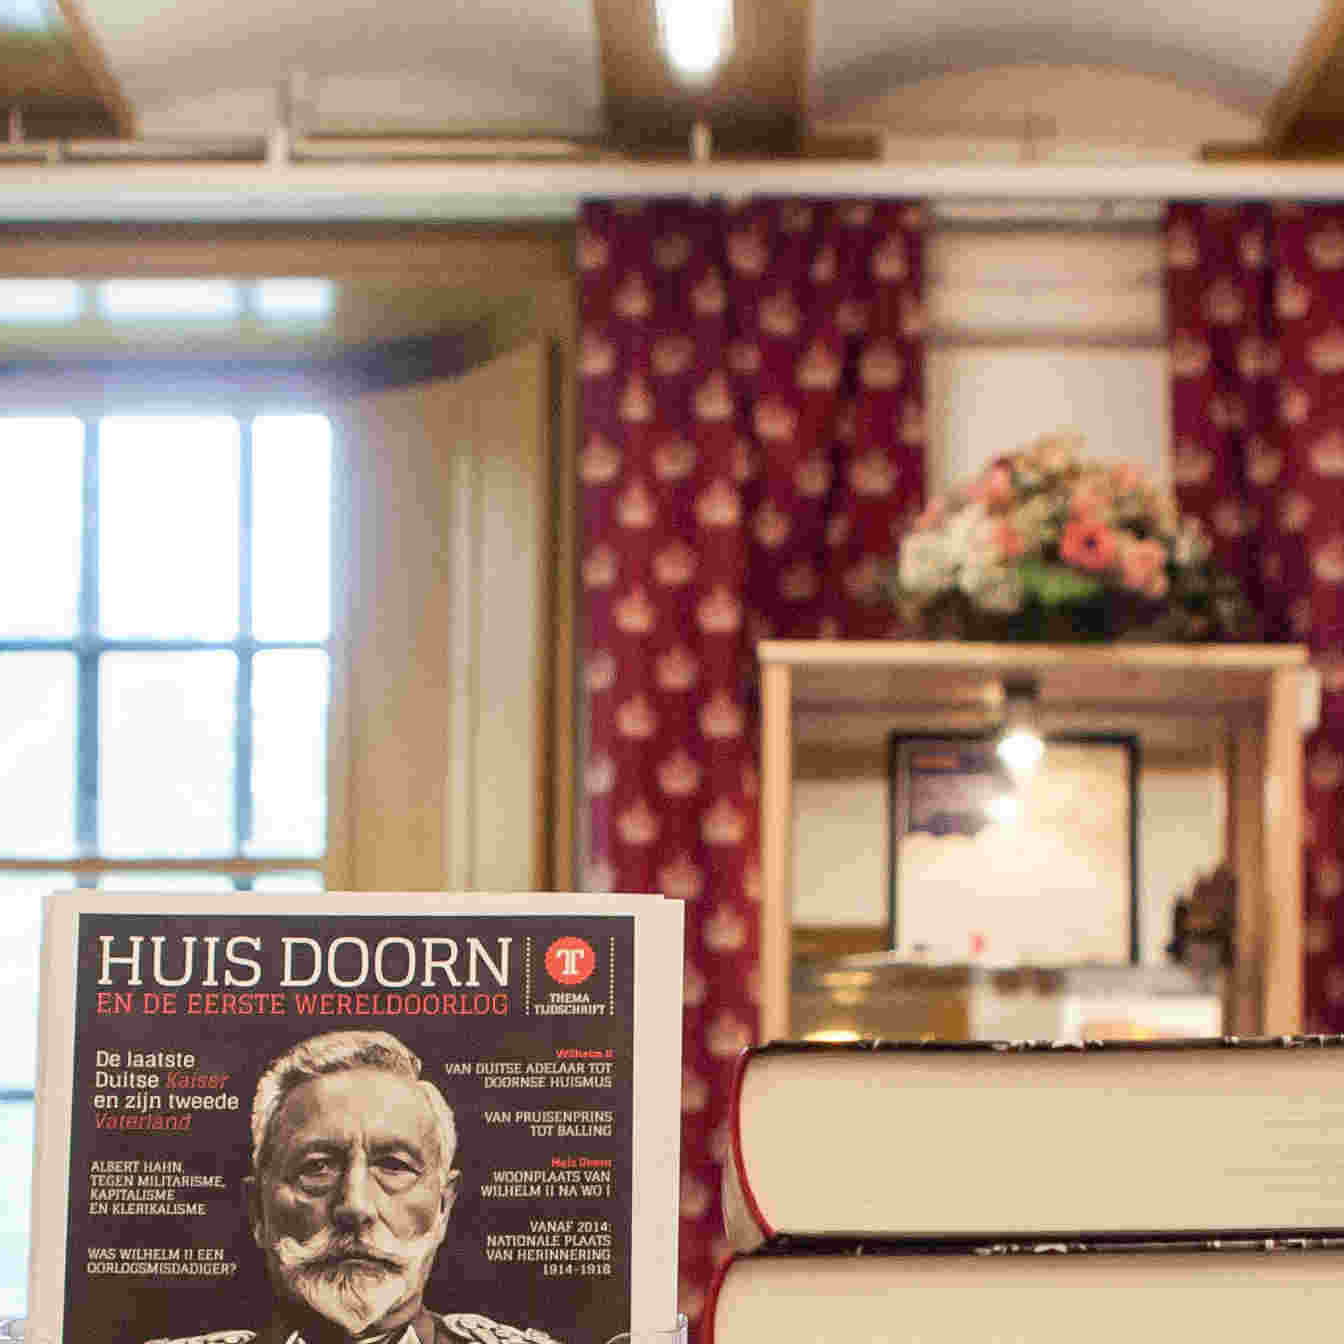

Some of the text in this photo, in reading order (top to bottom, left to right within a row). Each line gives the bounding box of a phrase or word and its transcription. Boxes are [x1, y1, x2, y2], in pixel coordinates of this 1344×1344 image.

[97, 935, 512, 987] HUIS DOORN
[556, 949, 585, 975] T
[549, 993, 590, 1003] THEMA
[97, 994, 509, 1017] EN DE EERSTE WERELDOORLOG
[96, 1051, 195, 1068] De laatste
[445, 1063, 613, 1074] VAN DUITSE ADELAAR TOT
[96, 1071, 159, 1088] Duitse
[484, 1077, 612, 1088] DOORNSE HUISMUS
[94, 1092, 240, 1112] en zijn tweede
[96, 1113, 193, 1130] Vaterland
[485, 1112, 613, 1122] VAN PRUISENPRINS
[530, 1126, 612, 1137] TOT BALLING
[90, 1161, 139, 1173] ALBERT
[90, 1175, 134, 1187] TEGEN
[493, 1171, 610, 1182] WOONPLAATS VAN
[90, 1189, 176, 1201] KAPITALISME
[481, 1185, 541, 1197] WILHELM
[559, 1185, 578, 1197] NA
[581, 1185, 602, 1197] WO
[88, 1203, 206, 1215] EN KLERIKALISME
[530, 1221, 573, 1232] VANAF
[487, 1235, 611, 1247] NATIONALE PLAATS
[87, 1248, 116, 1260] WAS
[119, 1248, 180, 1261] WILHELM
[197, 1248, 224, 1261] EEN
[486, 1249, 611, 1261] VAN HERINNERING
[87, 1262, 237, 1275] OORLOGSMISDADIGER?
